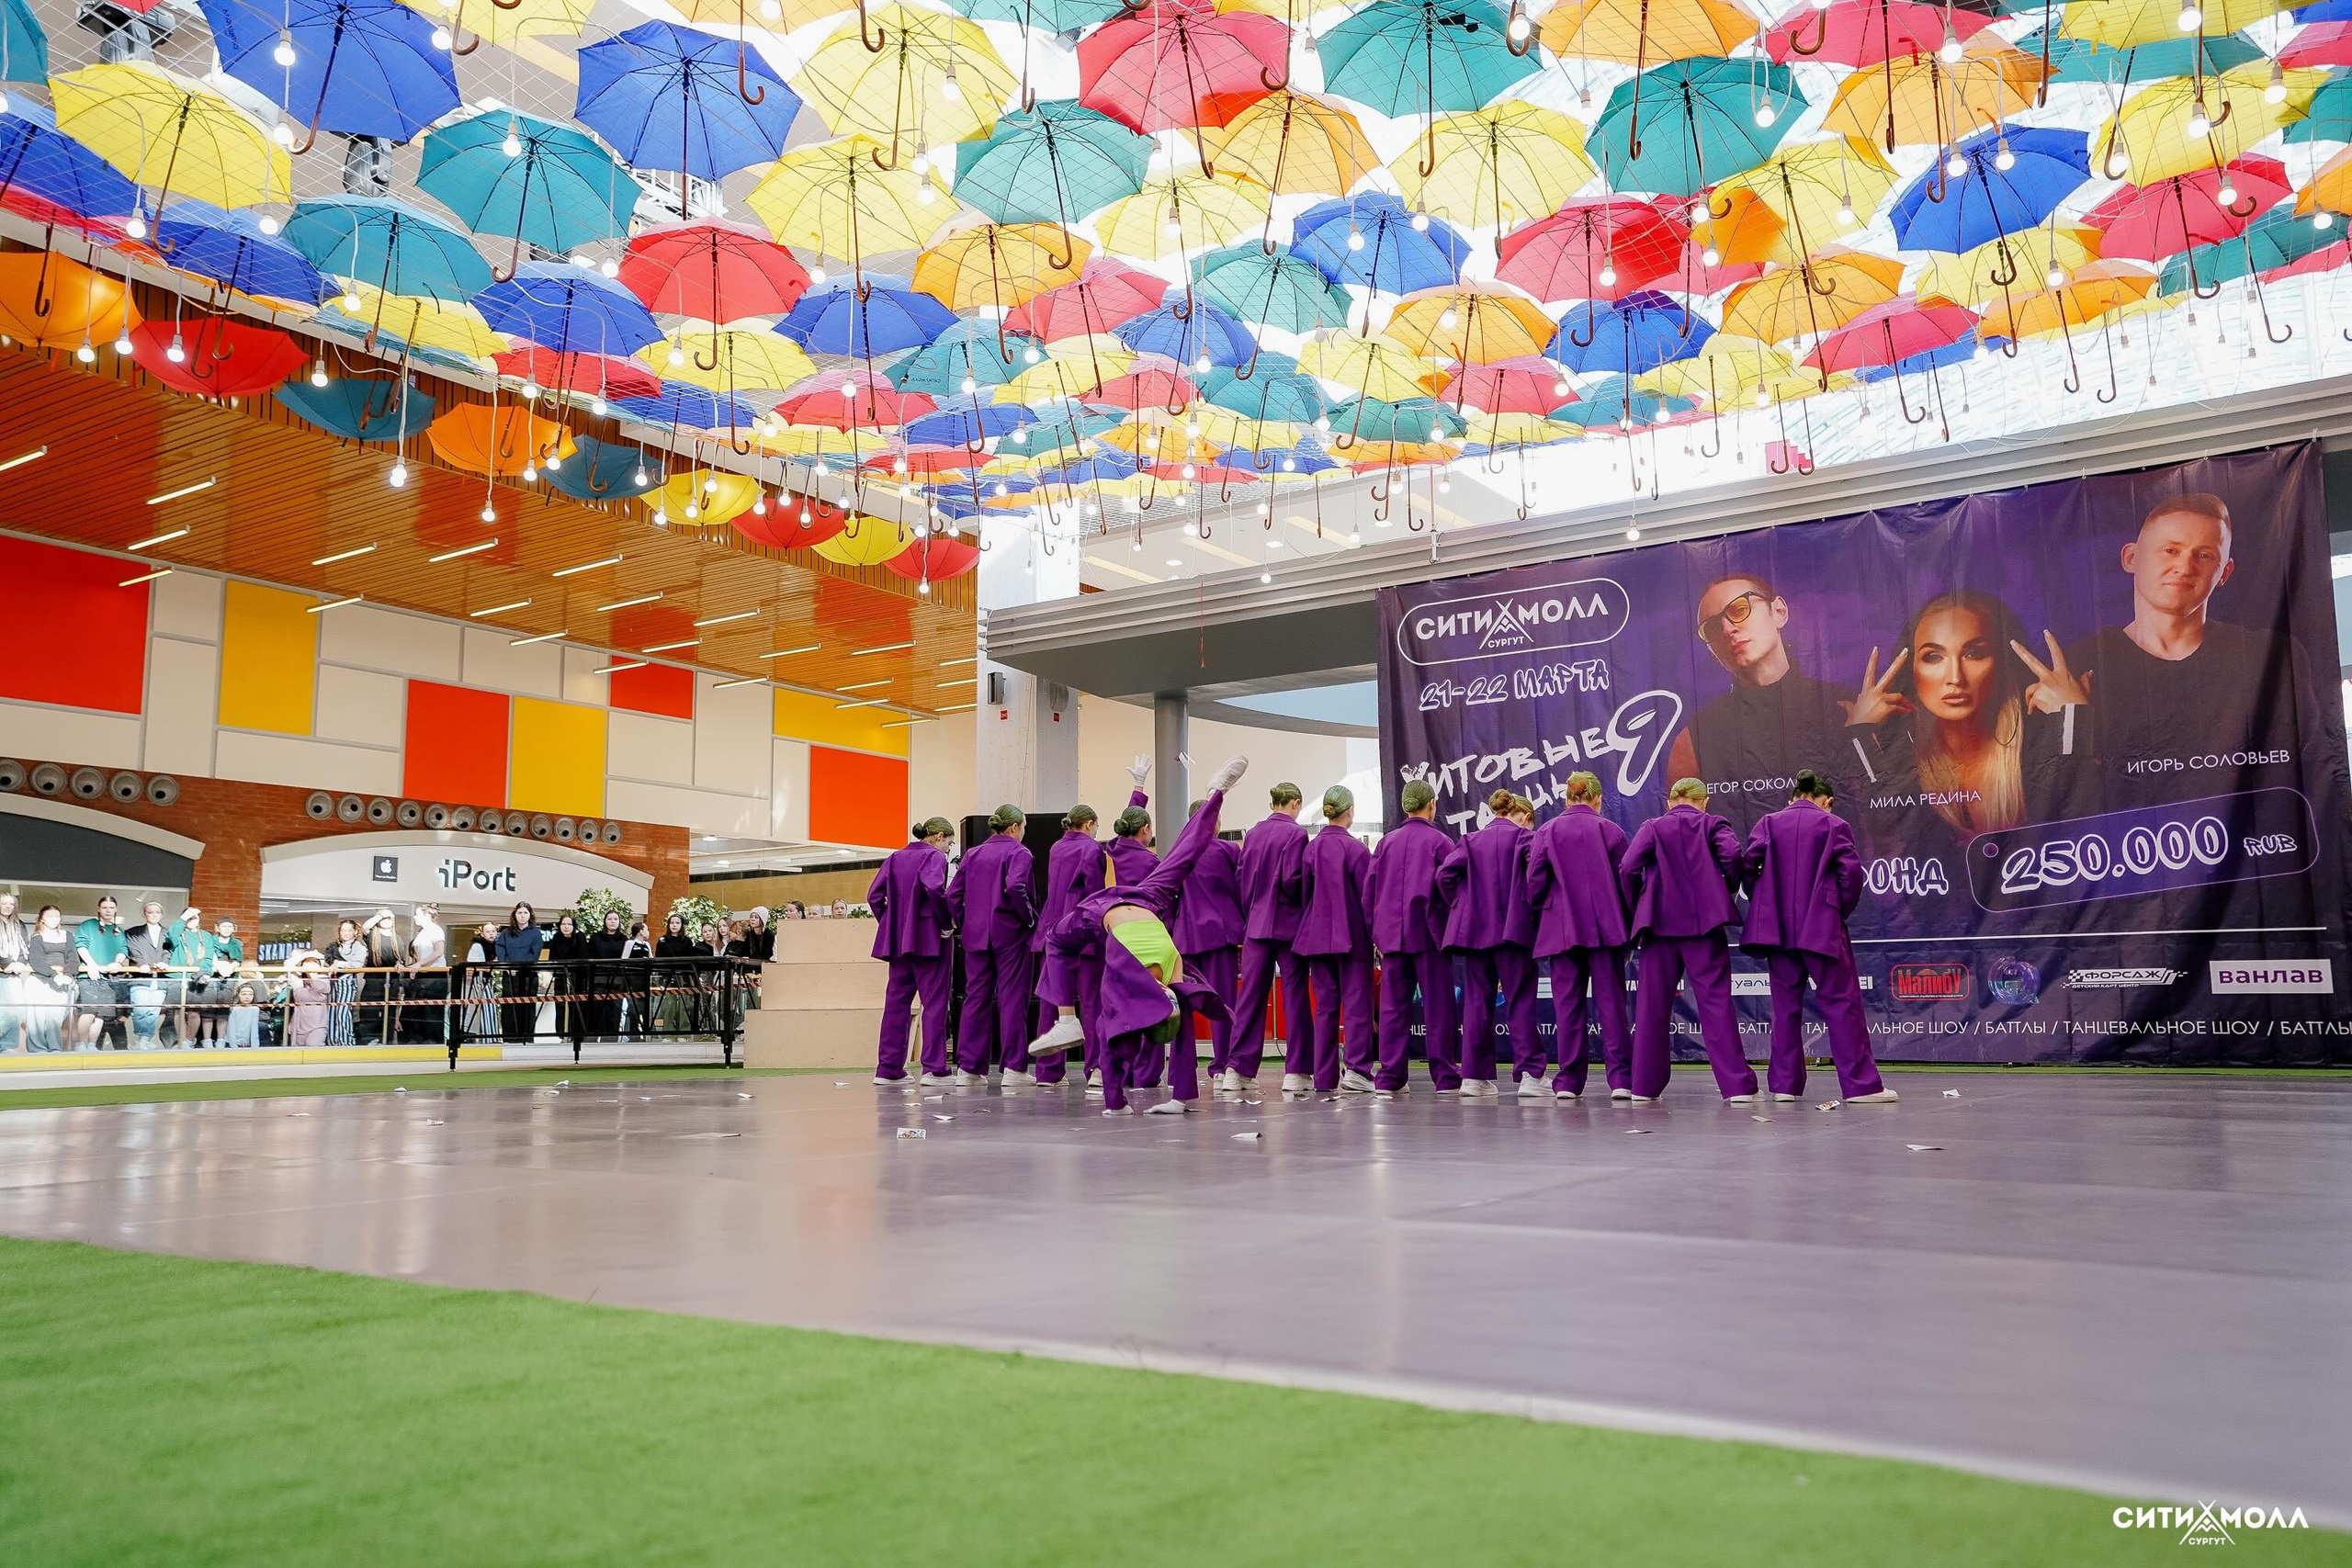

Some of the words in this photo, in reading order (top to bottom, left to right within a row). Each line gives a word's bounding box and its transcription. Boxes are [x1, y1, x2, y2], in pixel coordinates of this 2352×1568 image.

[1487, 636, 1525, 649] СУРГУТ
[1419, 674, 1509, 711] 21-22
[1514, 659, 1610, 700] МАРТА
[2127, 758, 2184, 773] ИГОРЬ
[2189, 750, 2290, 769] СОЛОВЬЕВ
[1706, 781, 1739, 795] ЕГОР
[1446, 773, 1568, 835] ТАЦ
[1870, 796, 1916, 809] МИЛА
[1919, 790, 1982, 806] РЕДИНА
[2001, 816, 2229, 895] 250.000
[2244, 834, 2298, 856] RUB
[438, 859, 516, 892] iPort
[1863, 856, 1949, 897] ОНД
[2085, 971, 2160, 979] ФОРСАЖ
[2219, 970, 2324, 984] ванлав
[1738, 1022, 1771, 1034] БАТТ
[1929, 1021, 1968, 1034] ШОУ
[1985, 1021, 2046, 1034] БАТТЛЫ
[2064, 1021, 2207, 1035] ТАНЦЕВАЛЬНОЕ
[2212, 1021, 2260, 1035] ШОУ
